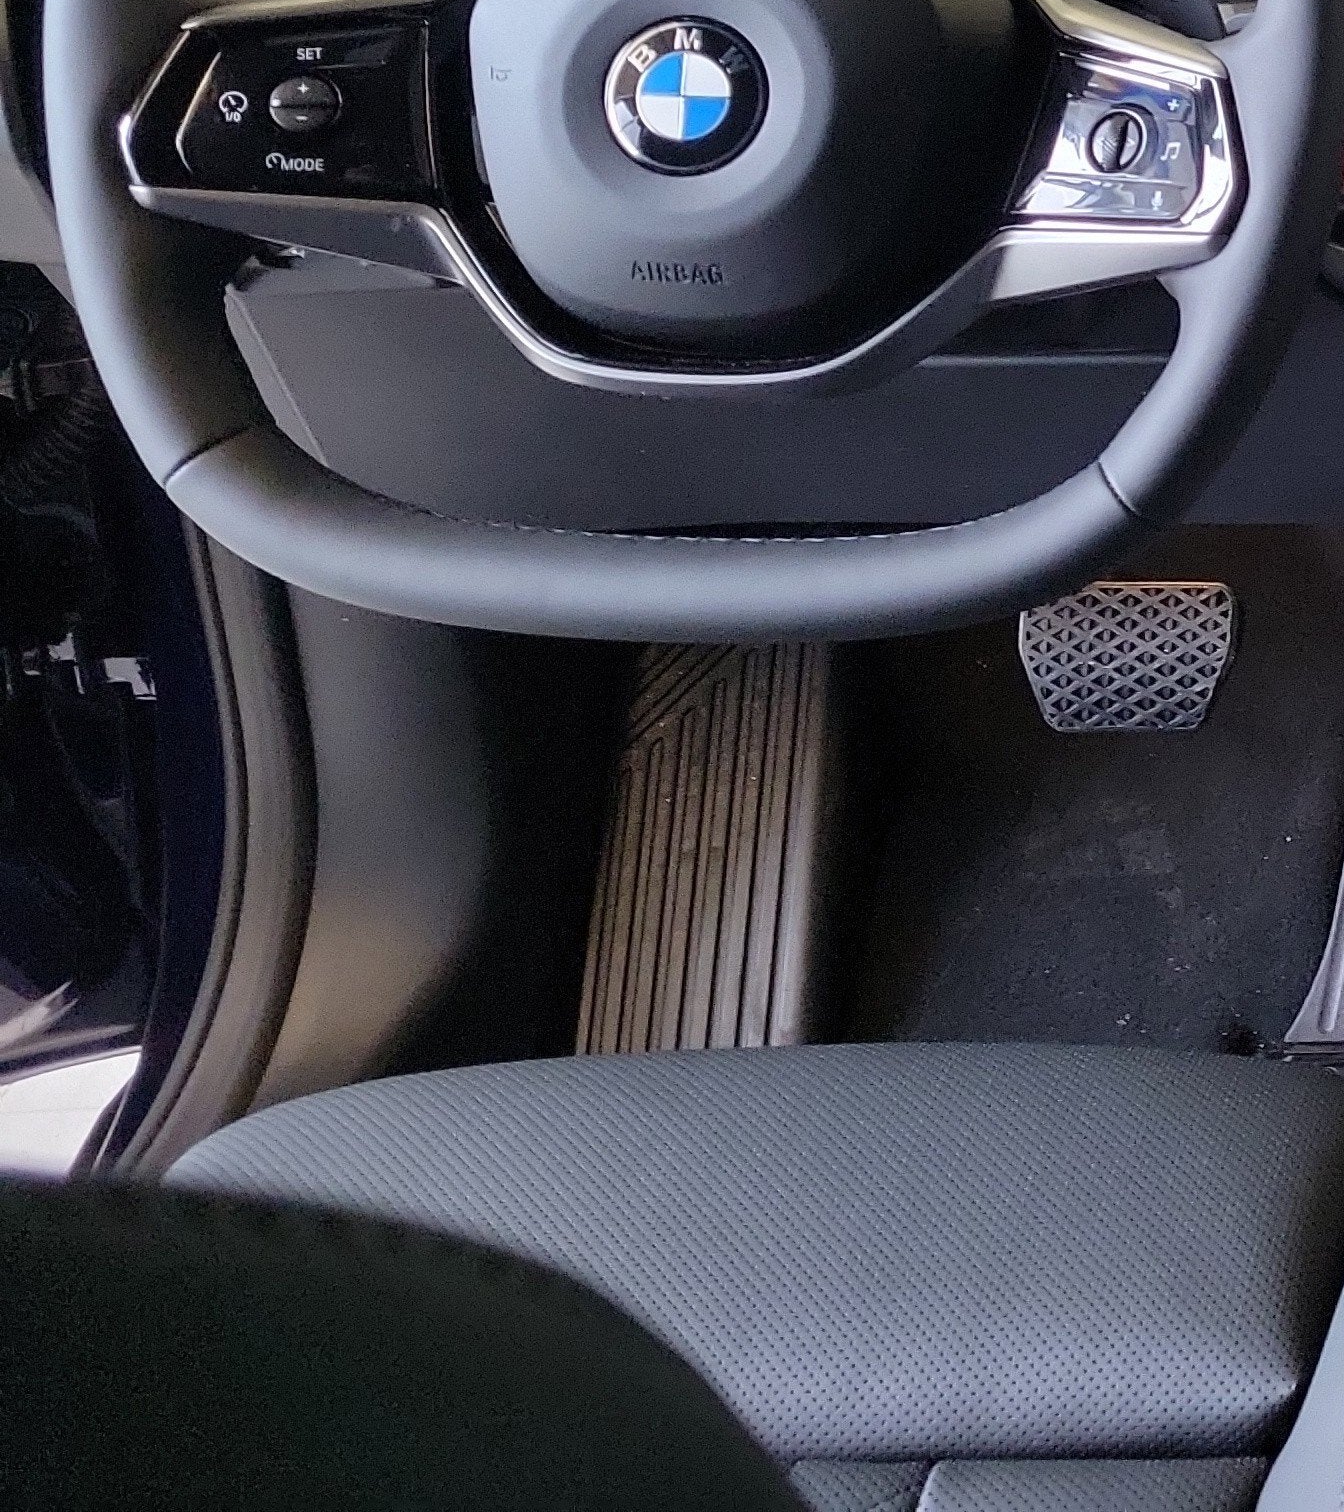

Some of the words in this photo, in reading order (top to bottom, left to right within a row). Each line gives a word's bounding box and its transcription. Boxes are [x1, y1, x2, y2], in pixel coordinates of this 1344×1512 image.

[296, 47, 322, 61] SET
[627, 28, 750, 74] BMW
[280, 158, 325, 172] MODE
[631, 260, 724, 285] AIRBAG
